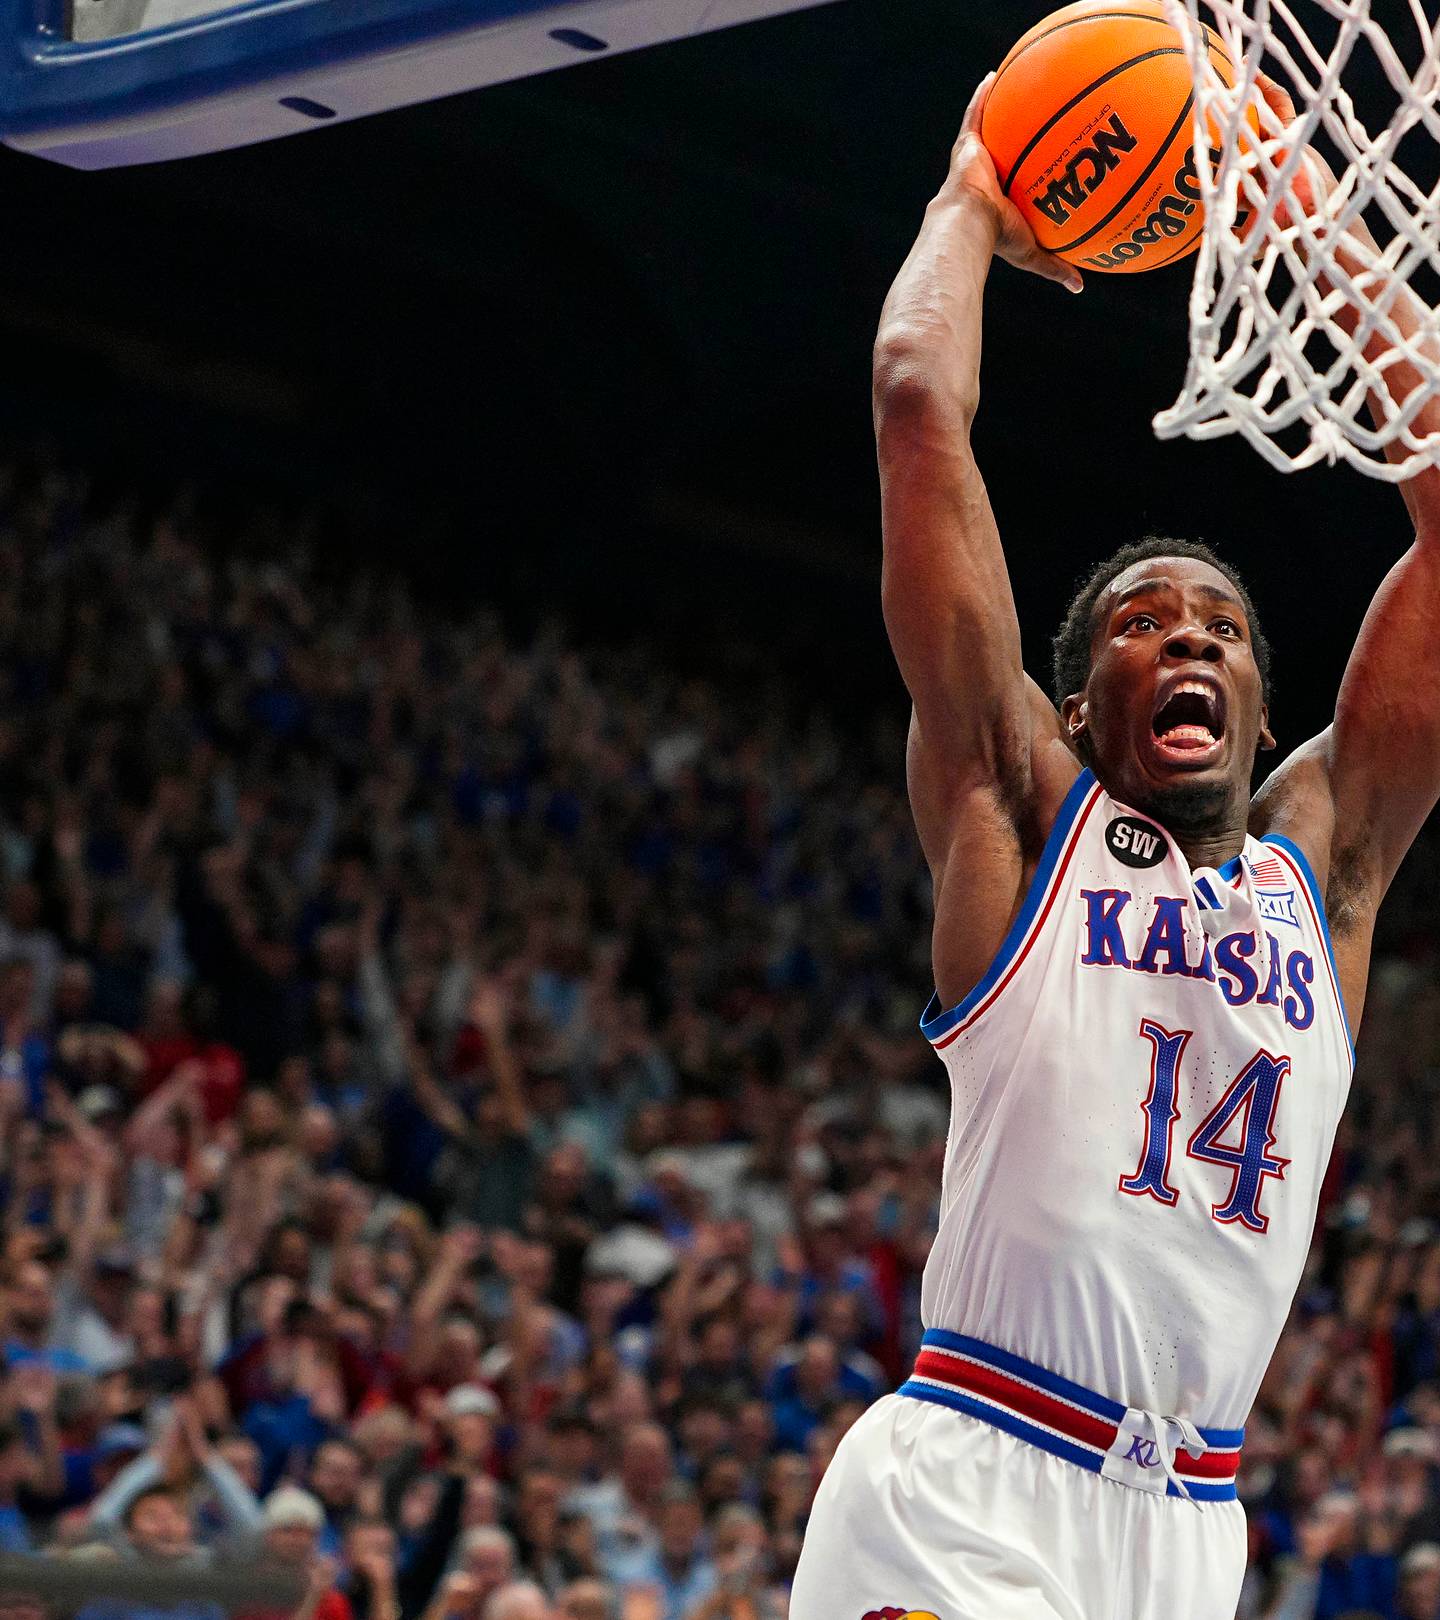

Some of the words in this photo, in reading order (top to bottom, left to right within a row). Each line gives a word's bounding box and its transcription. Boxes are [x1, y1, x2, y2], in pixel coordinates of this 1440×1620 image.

[1069, 103, 1112, 147] OFFICIAL
[1032, 111, 1138, 226] NCAA
[1044, 148, 1071, 177] GAME
[1112, 822, 1161, 860] SW
[1118, 1018, 1292, 1234] 14
